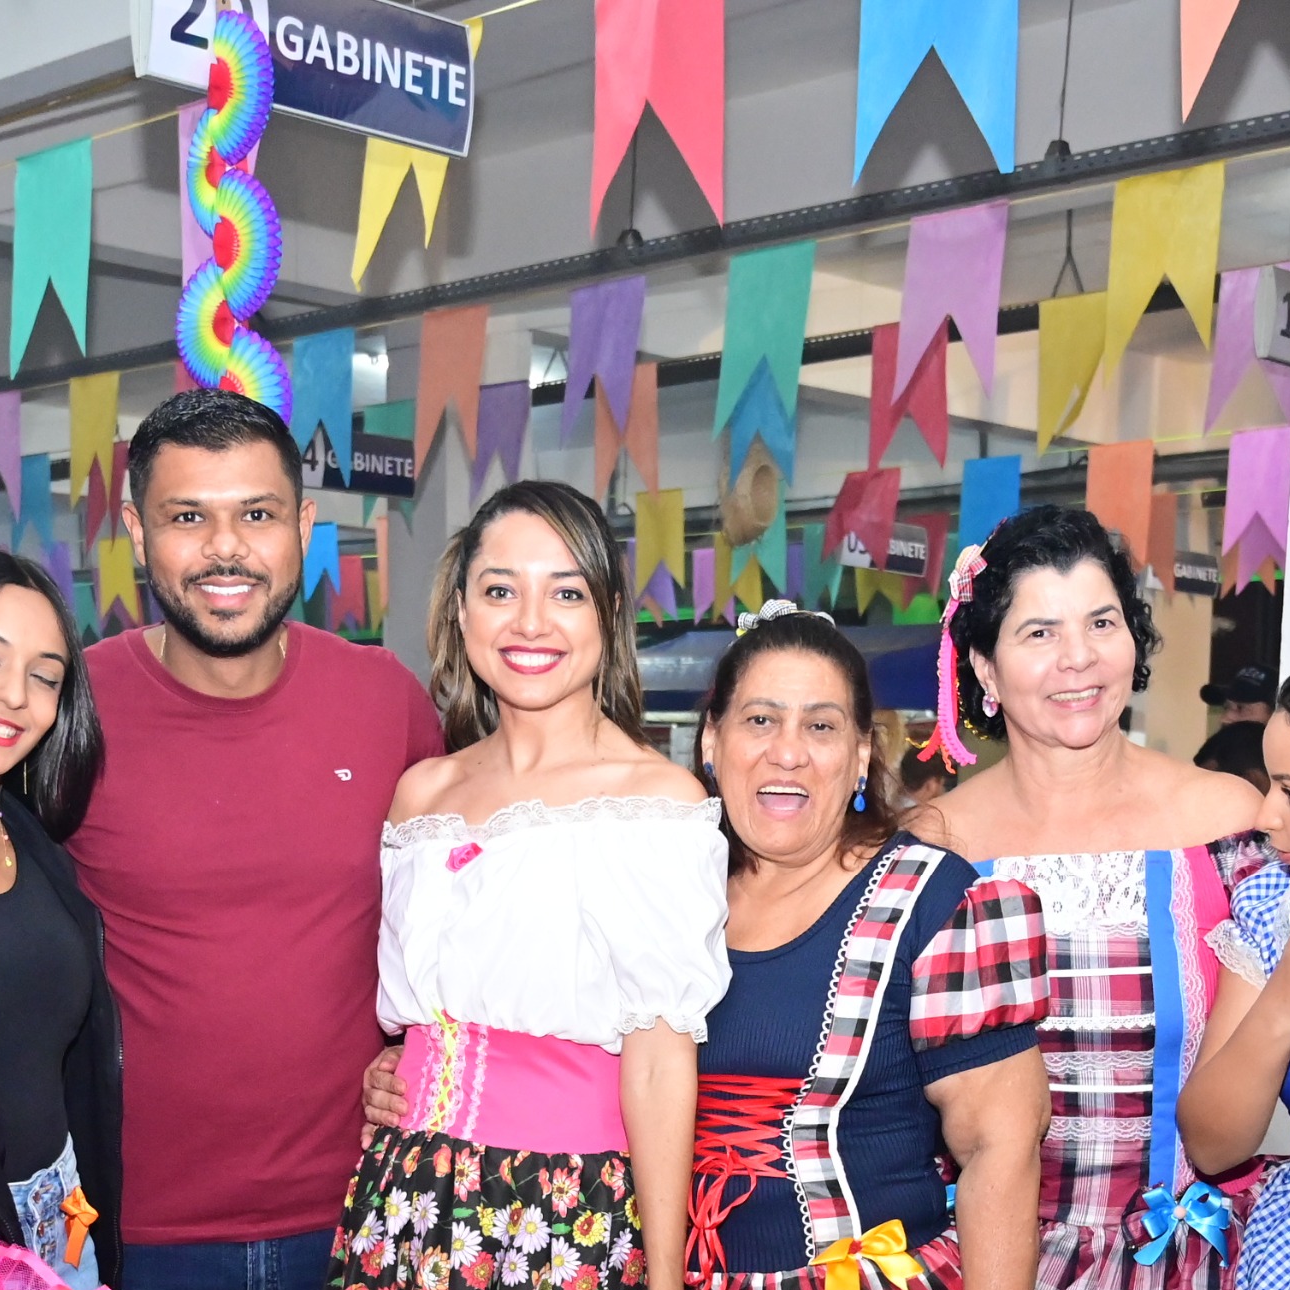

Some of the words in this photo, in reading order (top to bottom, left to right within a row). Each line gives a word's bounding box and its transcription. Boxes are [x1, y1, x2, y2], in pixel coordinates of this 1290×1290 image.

[275, 15, 466, 107] GABINETE
[326, 449, 414, 478] GBINETE
[888, 539, 925, 560] BINETE
